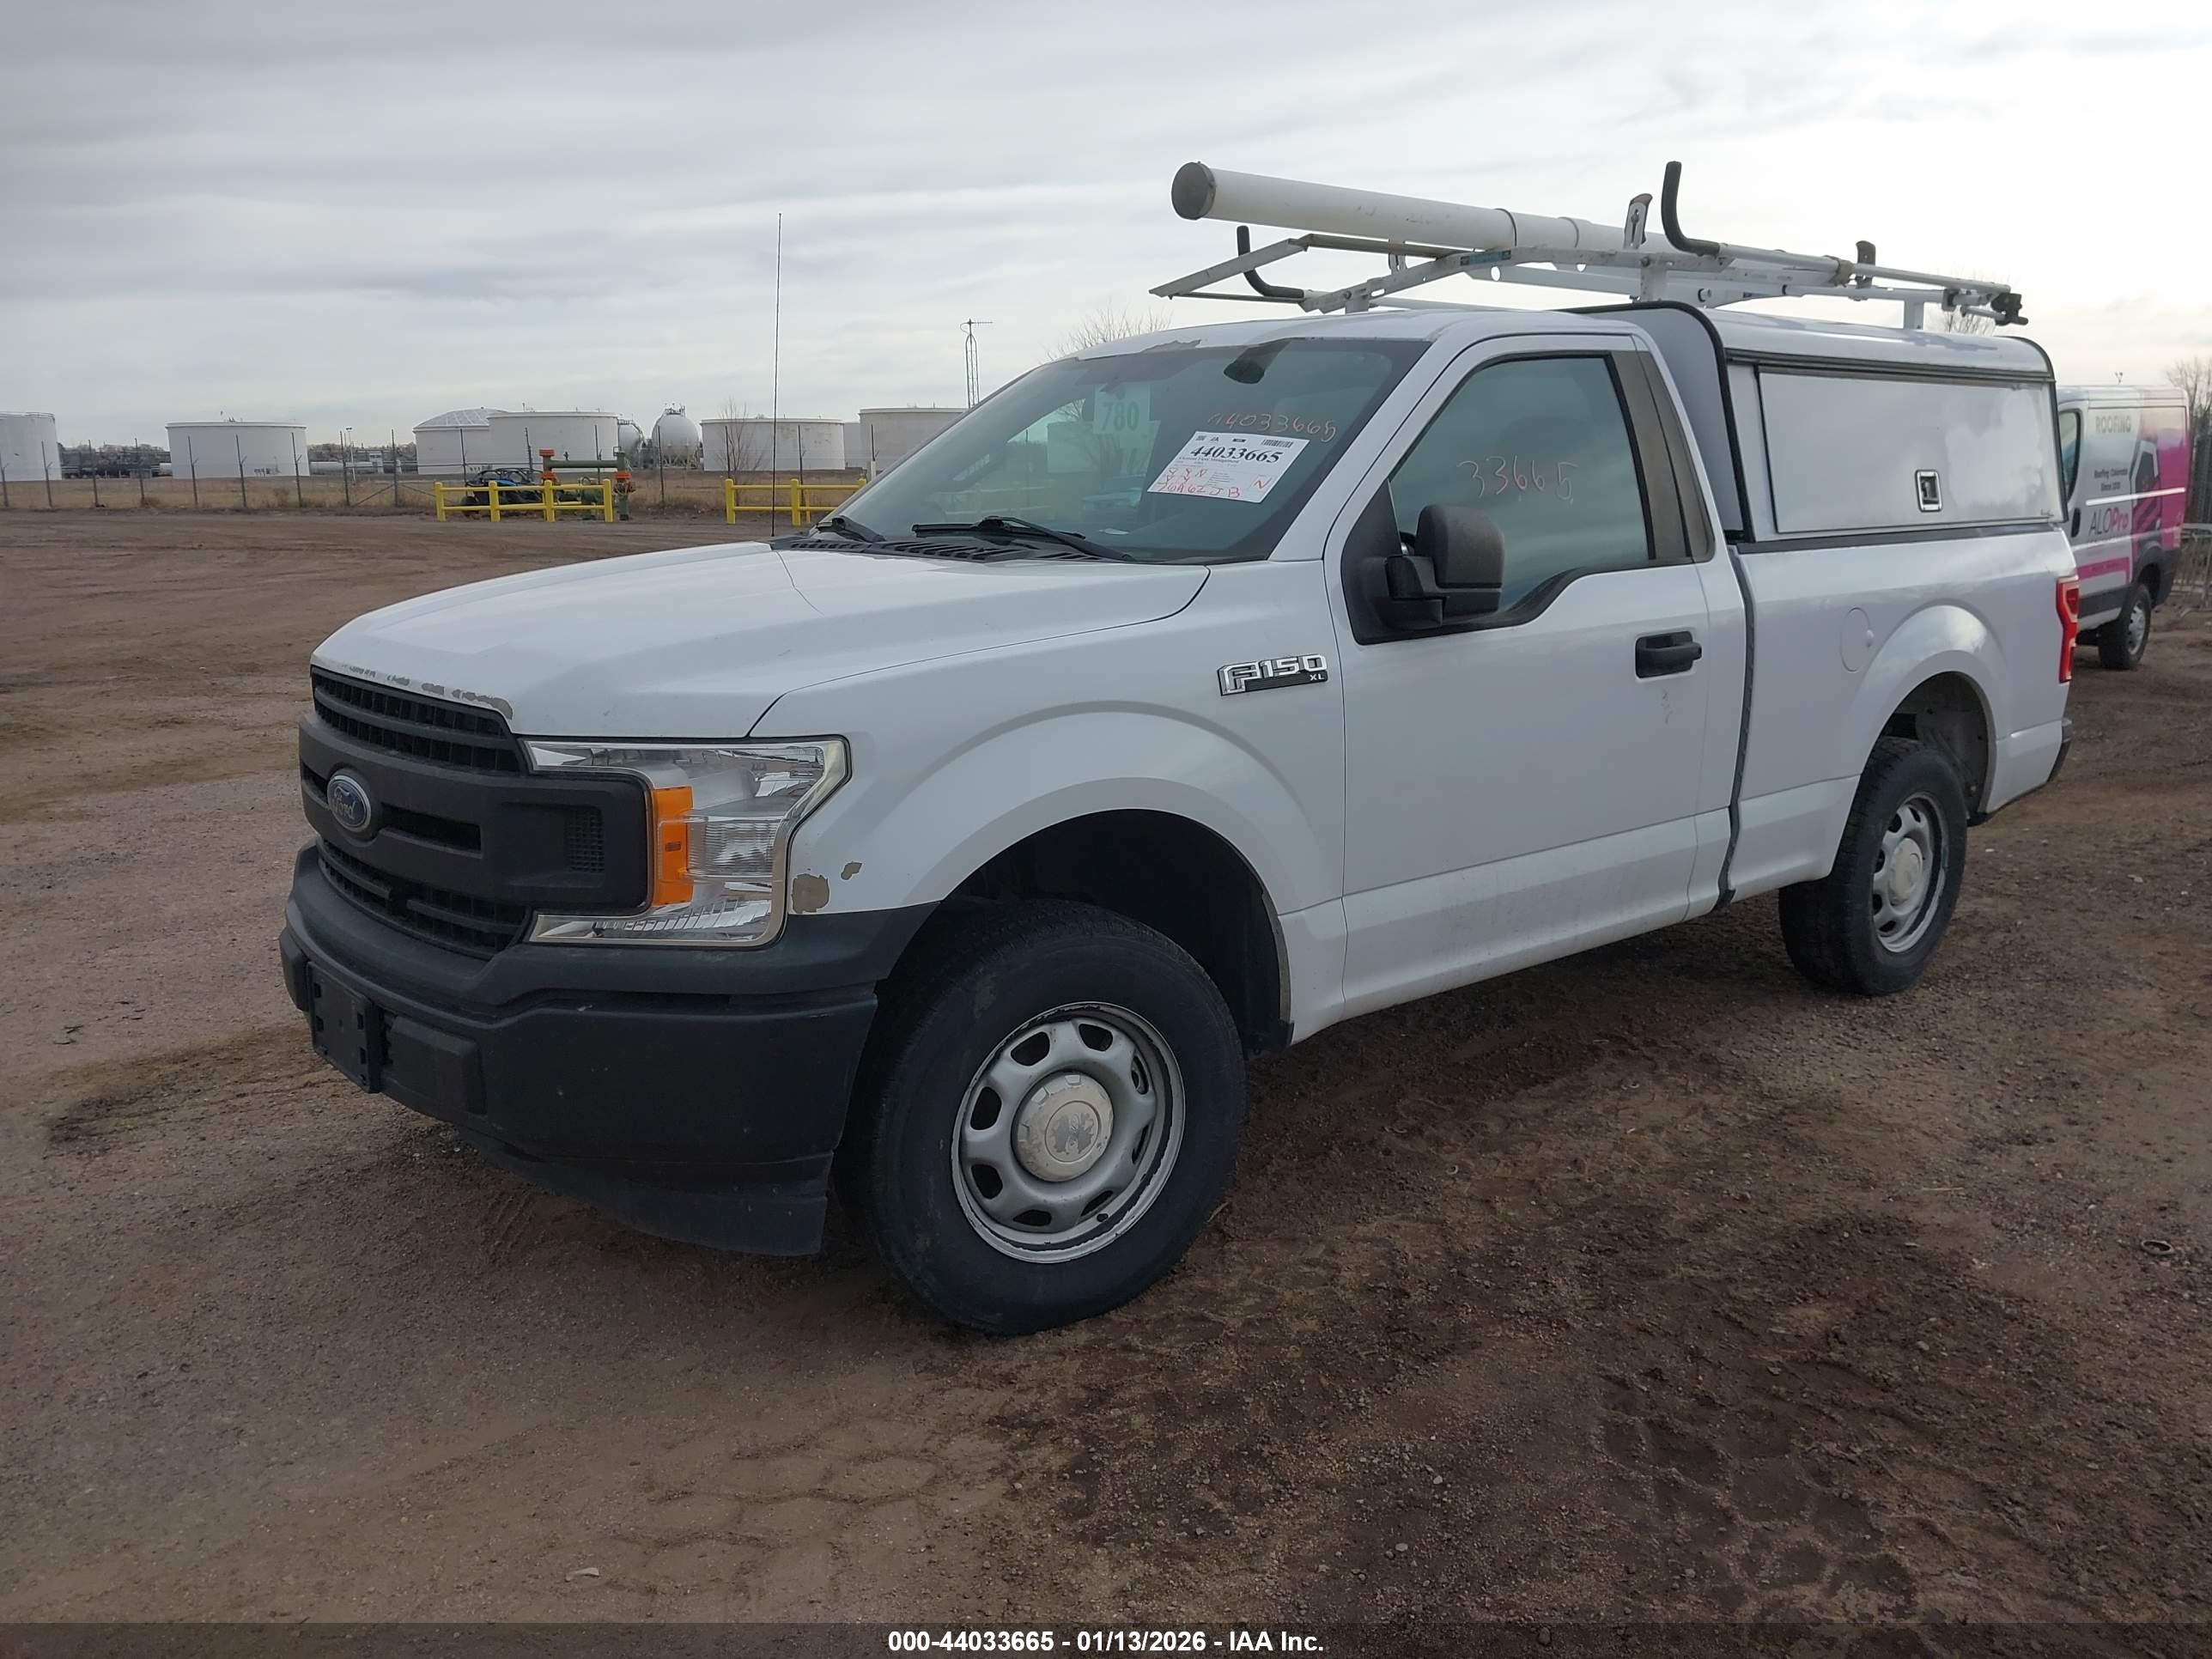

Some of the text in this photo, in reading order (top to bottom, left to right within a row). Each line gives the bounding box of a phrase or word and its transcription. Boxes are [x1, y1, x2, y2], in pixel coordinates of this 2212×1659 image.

[1190, 446, 1285, 463] 44033665
[1455, 454, 1579, 501] 33665
[1310, 672, 1326, 681] XL
